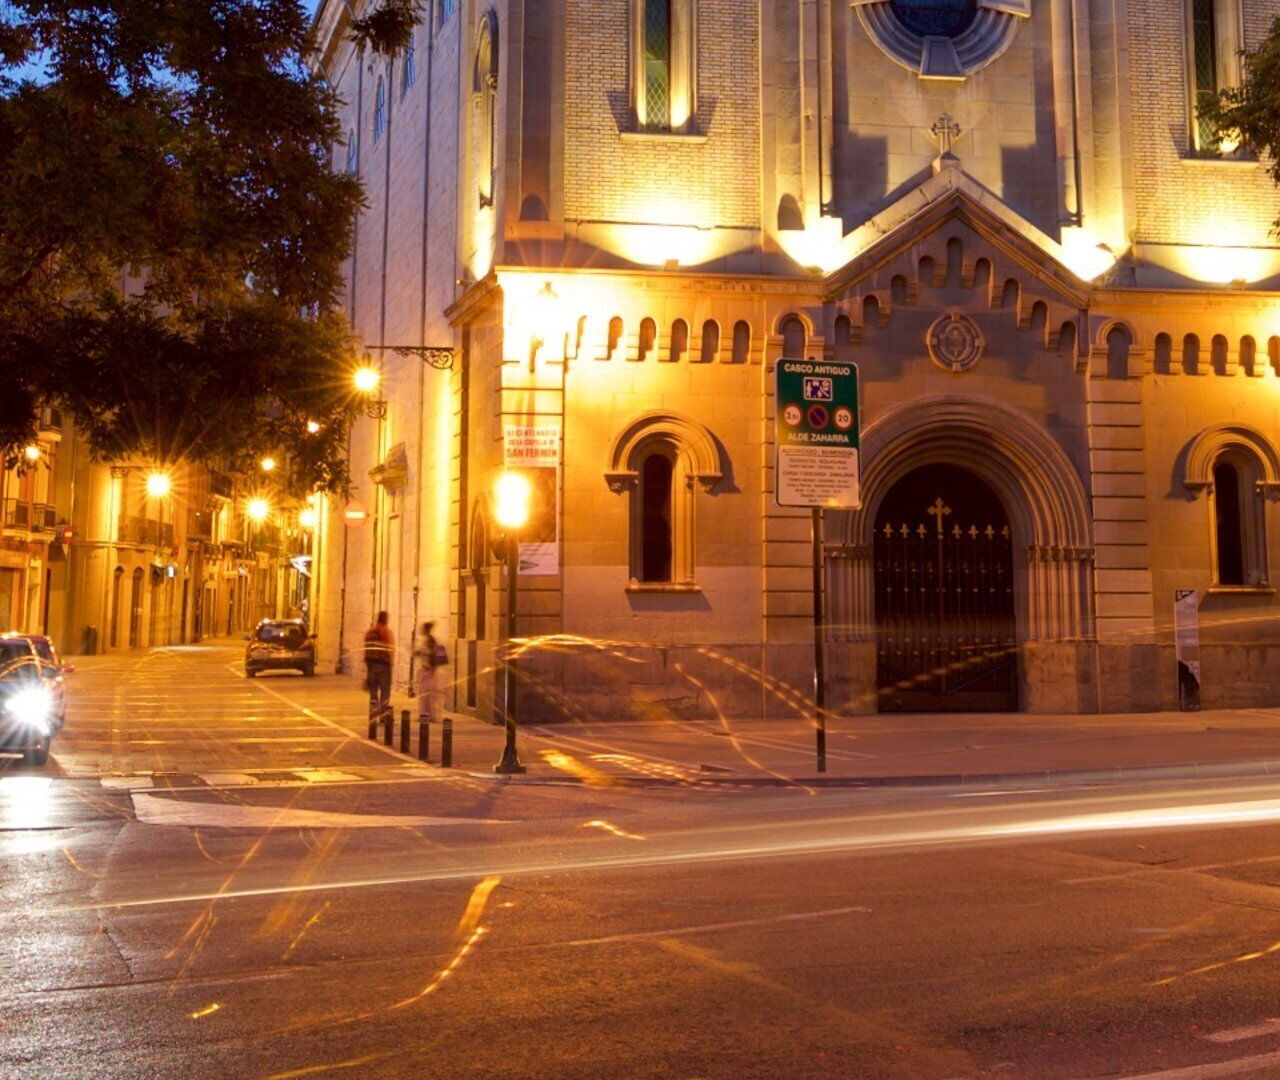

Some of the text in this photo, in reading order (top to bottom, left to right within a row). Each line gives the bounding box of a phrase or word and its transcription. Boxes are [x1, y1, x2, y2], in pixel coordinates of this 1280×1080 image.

[784, 363, 851, 376] CASCO ANTIGUO
[787, 432, 809, 442] ALDE
[507, 448, 524, 458] SAN
